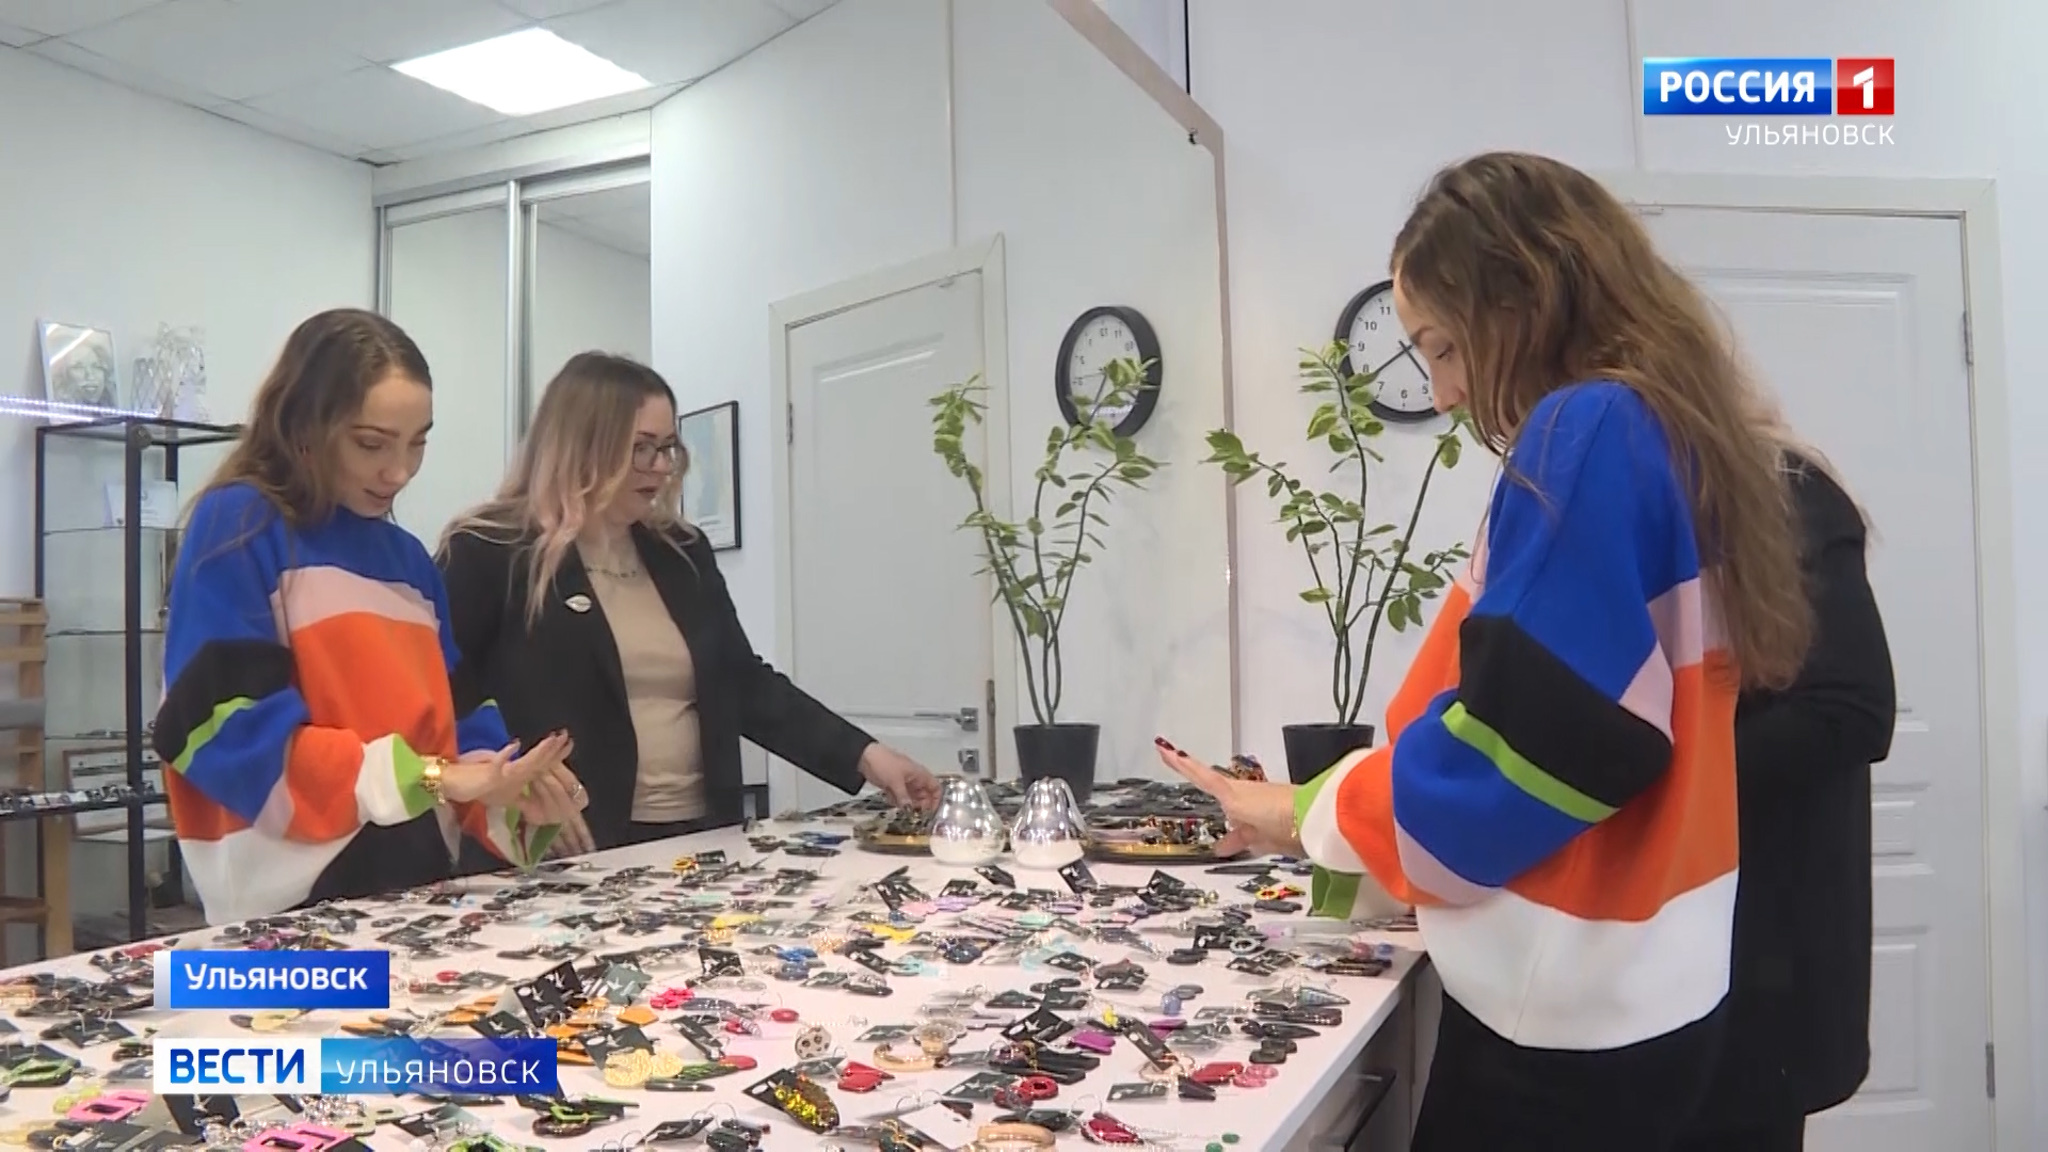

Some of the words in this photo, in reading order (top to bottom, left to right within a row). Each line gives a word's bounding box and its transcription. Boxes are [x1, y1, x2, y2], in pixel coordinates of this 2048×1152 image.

[1380, 306, 1391, 315] 11
[1364, 321, 1377, 330] 10
[1358, 341, 1365, 351] 9
[1377, 381, 1385, 391] 7
[1400, 389, 1408, 399] 6
